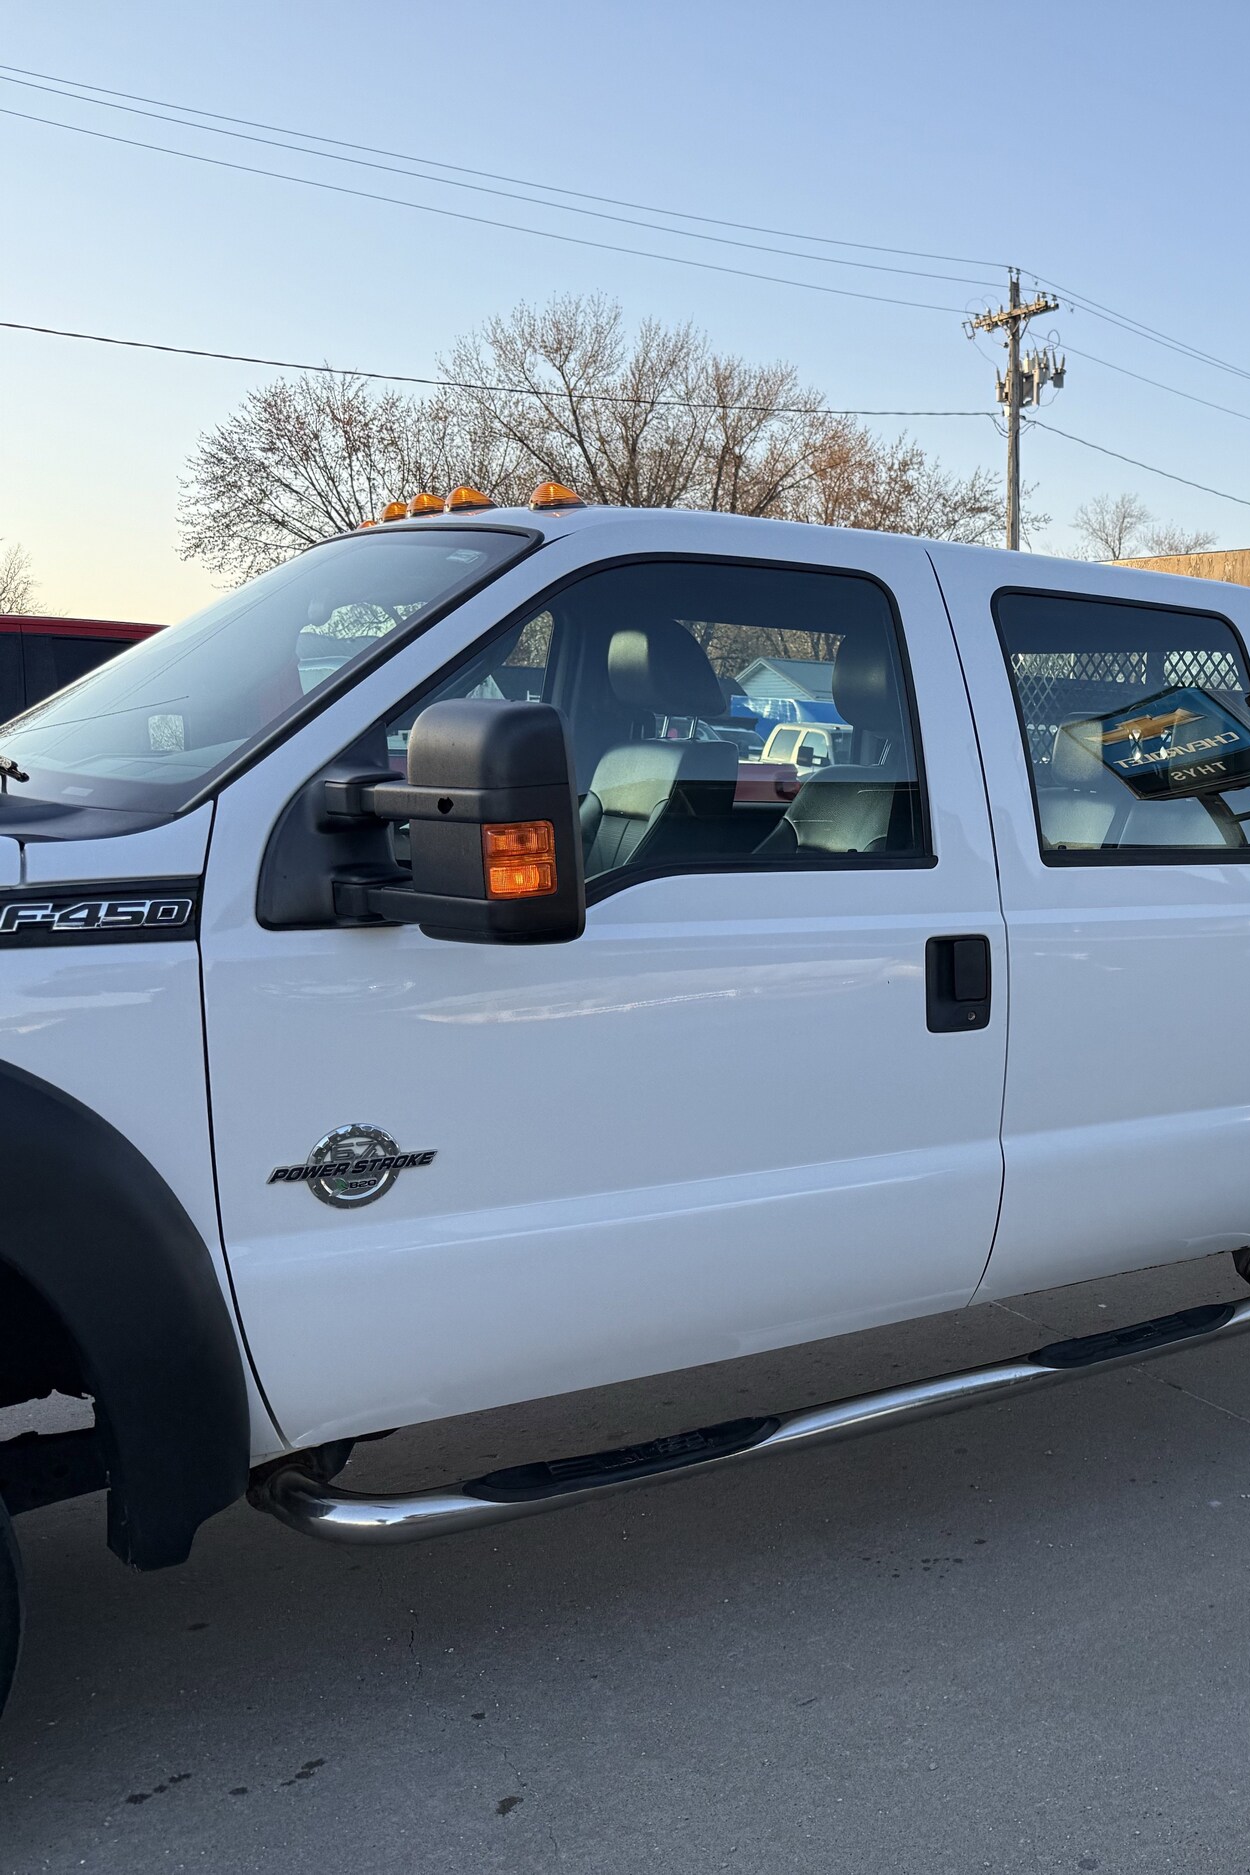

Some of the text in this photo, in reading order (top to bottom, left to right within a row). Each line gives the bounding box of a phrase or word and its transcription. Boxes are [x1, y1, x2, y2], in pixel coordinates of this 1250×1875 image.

[0, 899, 193, 933] F-450
[267, 1149, 438, 1184] POWER STROKE
